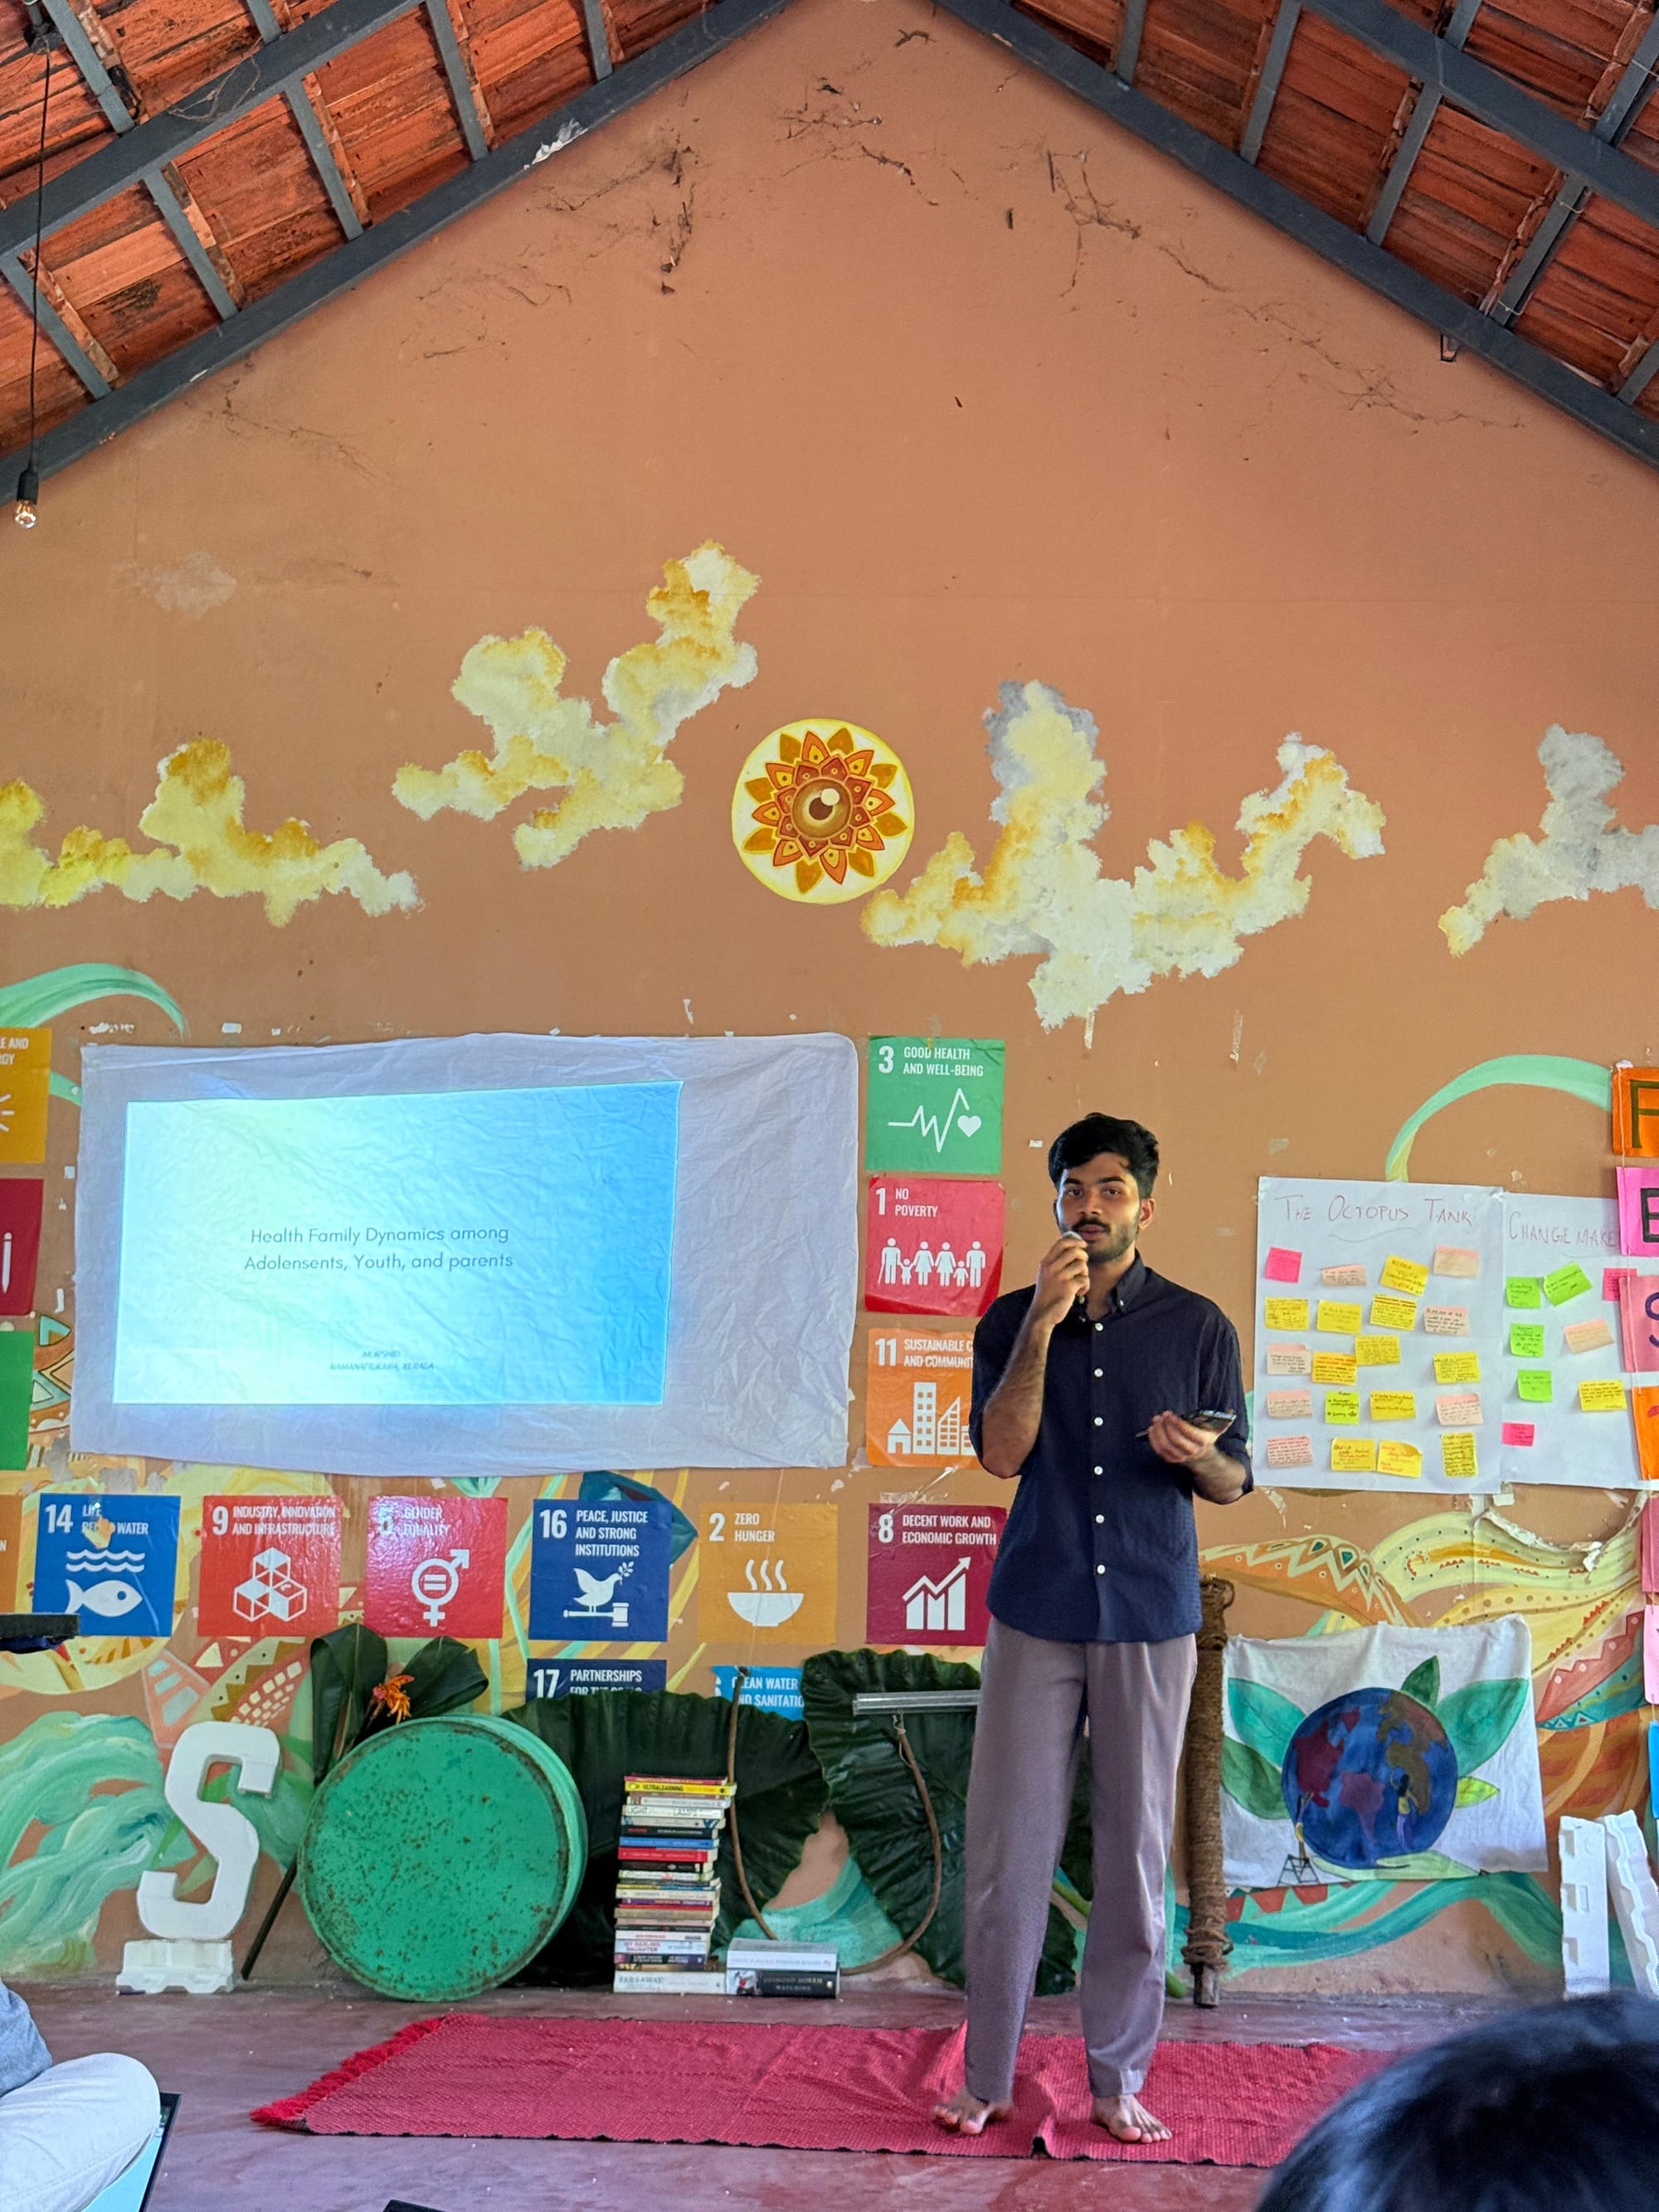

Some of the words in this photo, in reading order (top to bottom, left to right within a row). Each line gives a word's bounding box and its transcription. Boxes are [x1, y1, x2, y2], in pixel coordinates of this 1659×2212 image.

[8, 1038, 29, 1050] AND
[878, 1046, 894, 1073] 3
[904, 1047, 932, 1059] GOOD
[934, 1048, 970, 1060] HEALTH
[902, 1063, 923, 1075] AND
[927, 1064, 983, 1077] WELL-BEING
[1630, 1079, 1659, 1148] F
[895, 1188, 909, 1200] NO
[876, 1188, 886, 1216] 1
[895, 1205, 938, 1217] POVERTY
[1274, 1194, 1311, 1221] THE
[1327, 1194, 1408, 1222] OCTOPUS
[1424, 1198, 1472, 1227] TANK
[251, 1227, 303, 1242] Health
[309, 1227, 360, 1247] Family
[366, 1227, 445, 1246] Dynamics
[450, 1228, 508, 1243] among
[245, 1255, 348, 1271] Adolensents,
[354, 1253, 406, 1271] Youth,
[411, 1252, 443, 1268] and
[449, 1252, 513, 1271] parents
[875, 1338, 897, 1366] 11
[904, 1339, 964, 1352] SUSTAINABLE
[904, 1355, 923, 1367] AND
[925, 1356, 973, 1368] COMMUNIT
[45, 1504, 73, 1534] 14
[233, 1505, 280, 1519] INDUSTRY,
[282, 1505, 336, 1518] INNOVATION
[404, 1506, 443, 1519] GENDER
[577, 1510, 609, 1524] PEACE,
[611, 1511, 648, 1523] JUSTICE
[735, 1513, 760, 1524] ZERO
[212, 1505, 228, 1535] 9
[378, 1506, 394, 1535] 5
[540, 1509, 567, 1539] 16
[709, 1512, 725, 1541] 2
[902, 1514, 938, 1527] DECENT
[941, 1515, 969, 1527] WORK
[971, 1516, 991, 1528] AND
[117, 1522, 149, 1534] WATER
[232, 1523, 252, 1534] AND
[254, 1523, 335, 1535] INFRASTRUCTURE
[576, 1527, 596, 1539] AND
[598, 1528, 637, 1539] STRONG
[878, 1514, 893, 1543] 8
[734, 1529, 775, 1542] HUNGER
[902, 1532, 953, 1544] ECONOMIC
[955, 1533, 996, 1544] GROWTH
[575, 1544, 640, 1557] INSTITUTIONS
[570, 1669, 642, 1682] PARTNERSHIPS
[533, 1669, 560, 1698] 17
[765, 1677, 798, 1689] WATER
[755, 1694, 805, 1708] SANITATIO
[137, 1722, 280, 1939] S
